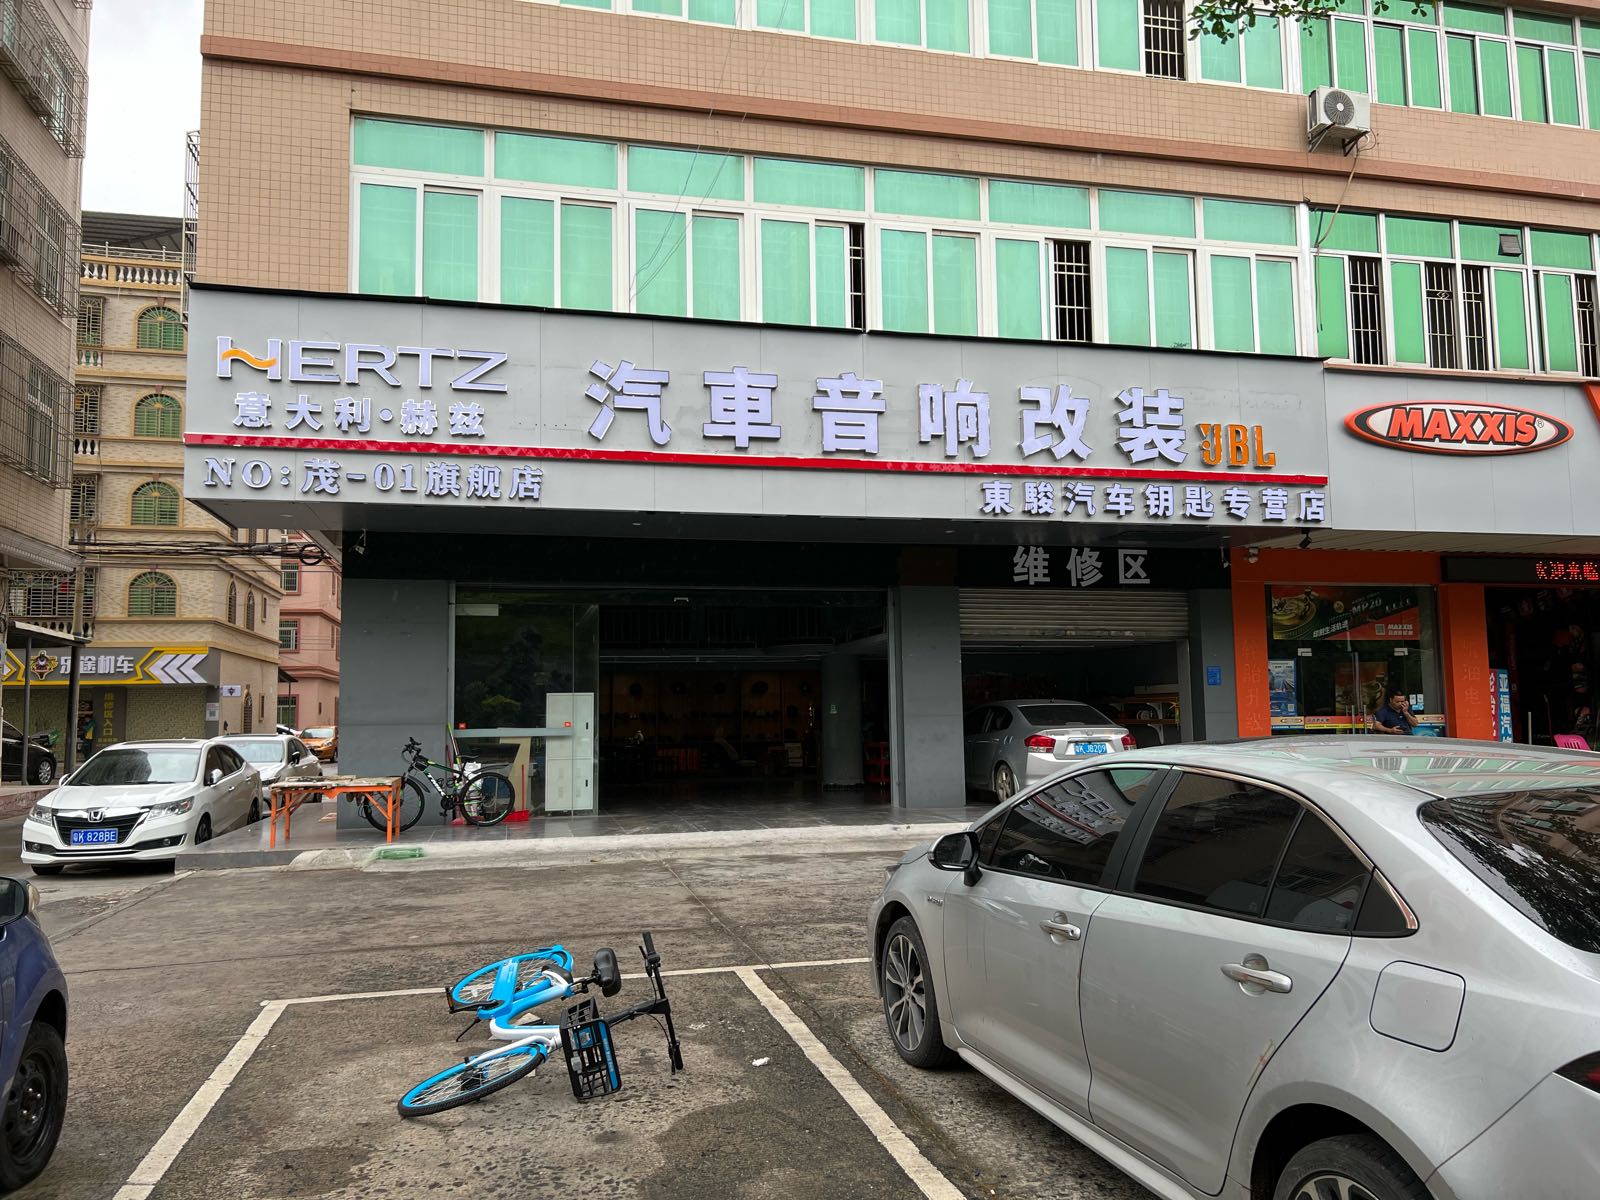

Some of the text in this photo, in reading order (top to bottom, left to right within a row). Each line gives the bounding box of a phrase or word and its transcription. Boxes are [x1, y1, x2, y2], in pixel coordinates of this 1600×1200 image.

[216, 335, 508, 392] HERTZ
[233, 391, 486, 437] 意大利·赫兹
[584, 359, 1189, 465] 汽車音响改装
[1387, 408, 1538, 445] MAXXIS
[1199, 423, 1277, 468] JBL
[981, 480, 1327, 523] 東駿汽车钥匙专营店
[1012, 545, 1151, 587] 维修区
